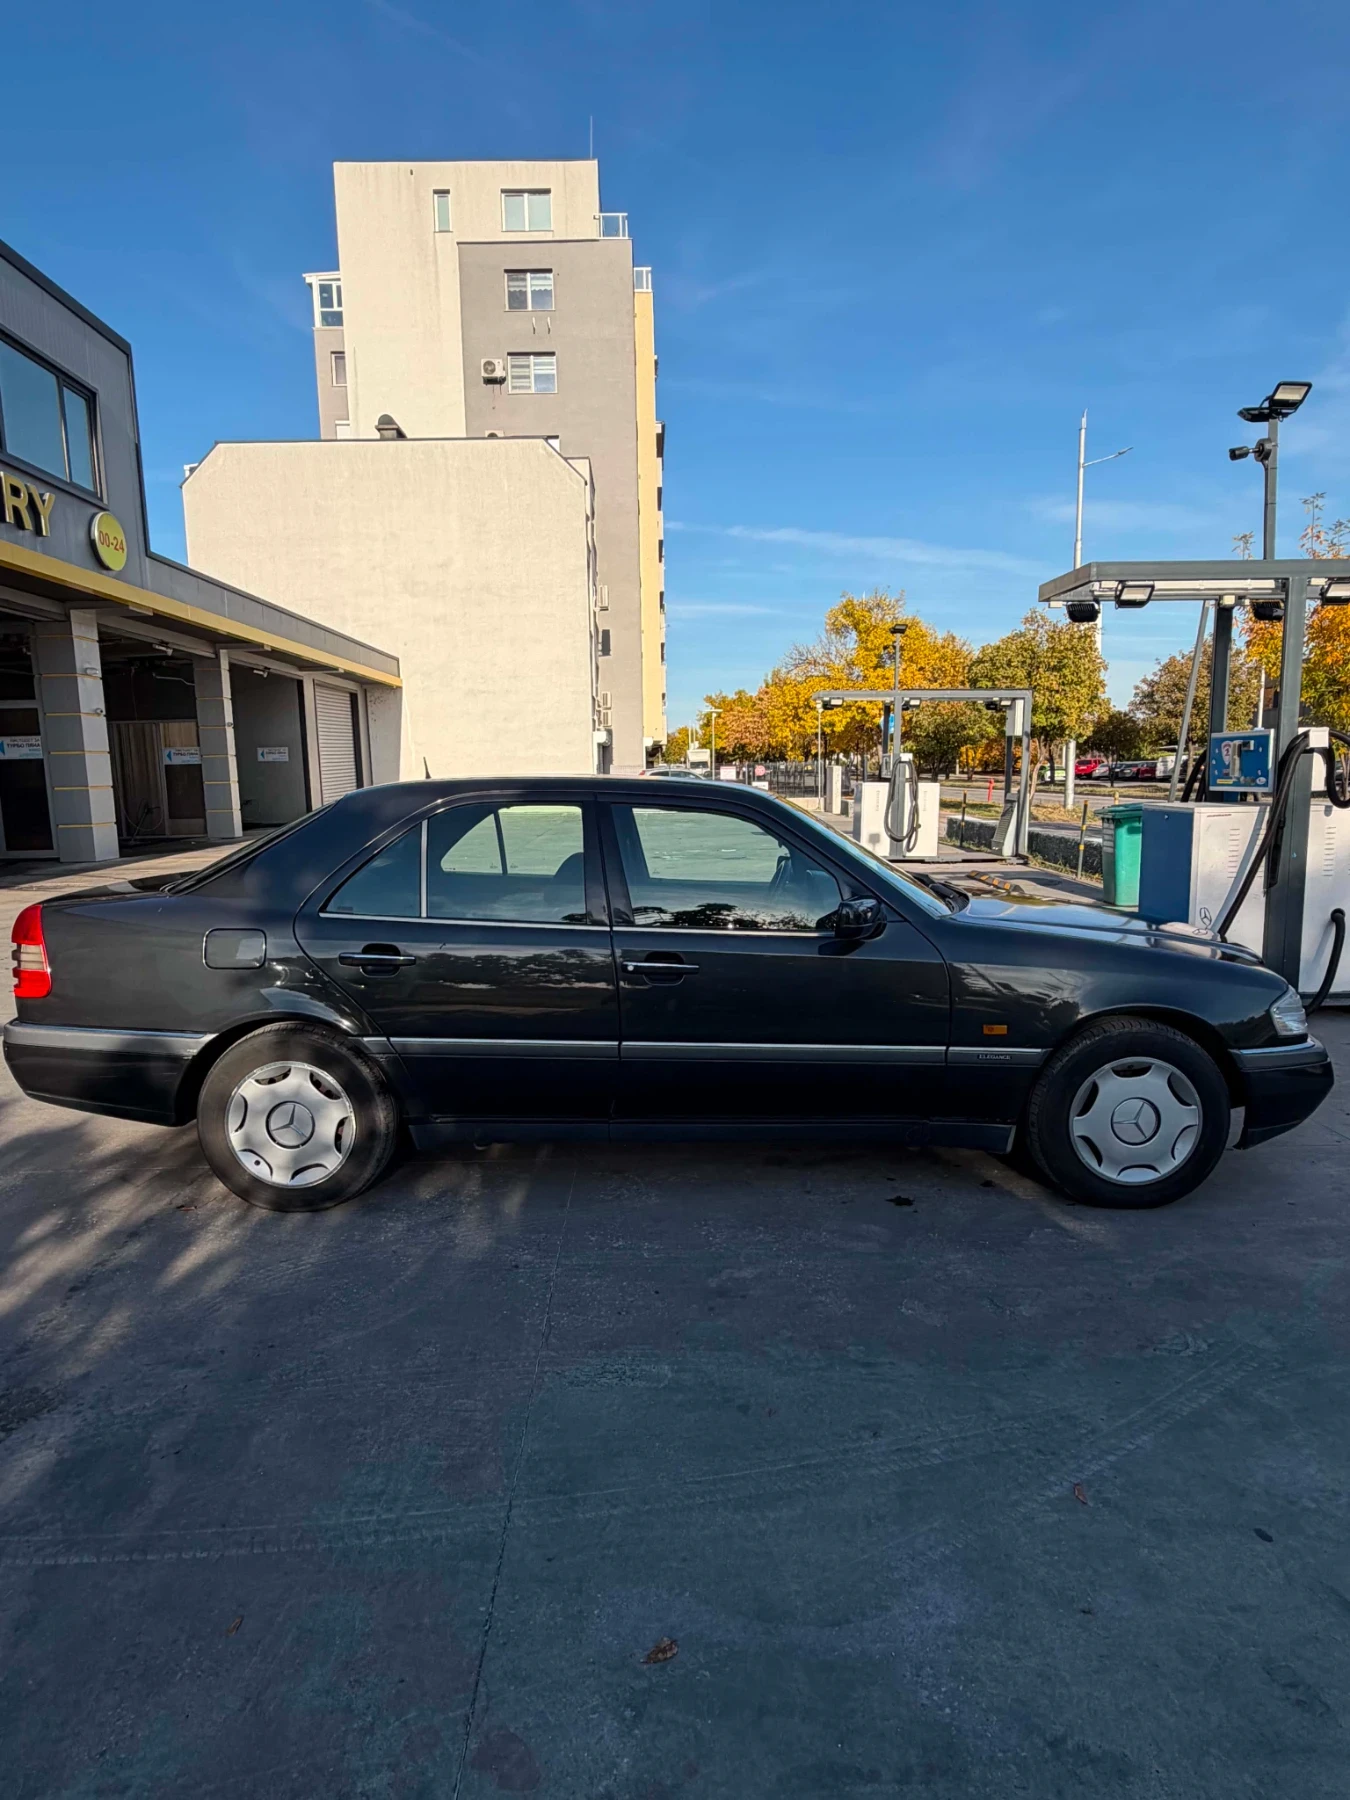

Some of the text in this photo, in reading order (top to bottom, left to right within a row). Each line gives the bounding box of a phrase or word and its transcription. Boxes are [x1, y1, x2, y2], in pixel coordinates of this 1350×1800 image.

[0, 471, 55, 537] RY
[98, 530, 125, 554] 00-24
[978, 1053, 1011, 1061] ELEGANCE
